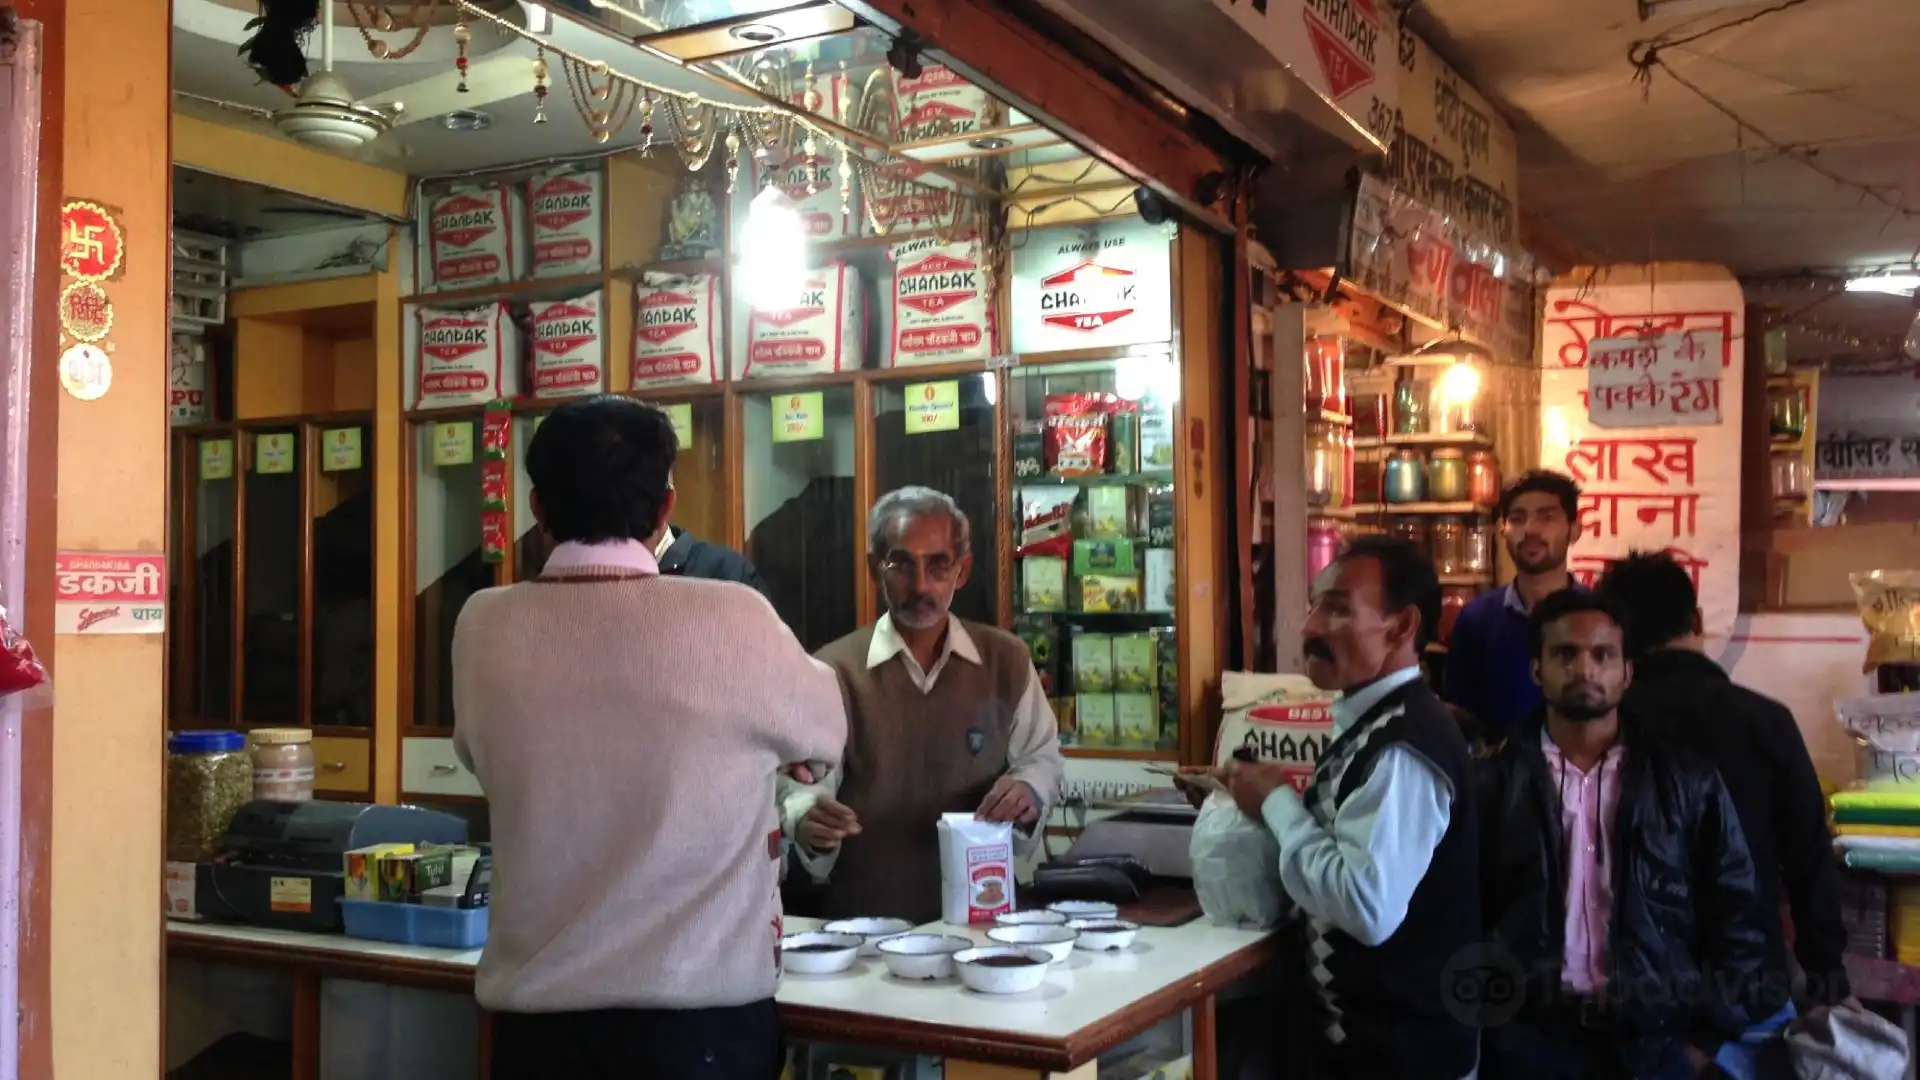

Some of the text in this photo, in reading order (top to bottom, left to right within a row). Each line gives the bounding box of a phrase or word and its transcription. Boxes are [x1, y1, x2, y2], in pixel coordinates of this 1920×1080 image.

[1306, 0, 1378, 64] HANDAK
[1058, 238, 1126, 255] ALWAYS USE
[899, 271, 977, 295] CHANDAK
[922, 298, 944, 308] TEA
[1041, 284, 1137, 310] CHAK
[640, 307, 696, 325] ANDAK
[1074, 315, 1104, 328] TEA
[131, 608, 163, 621] चाय
[1287, 706, 1331, 720] BEST
